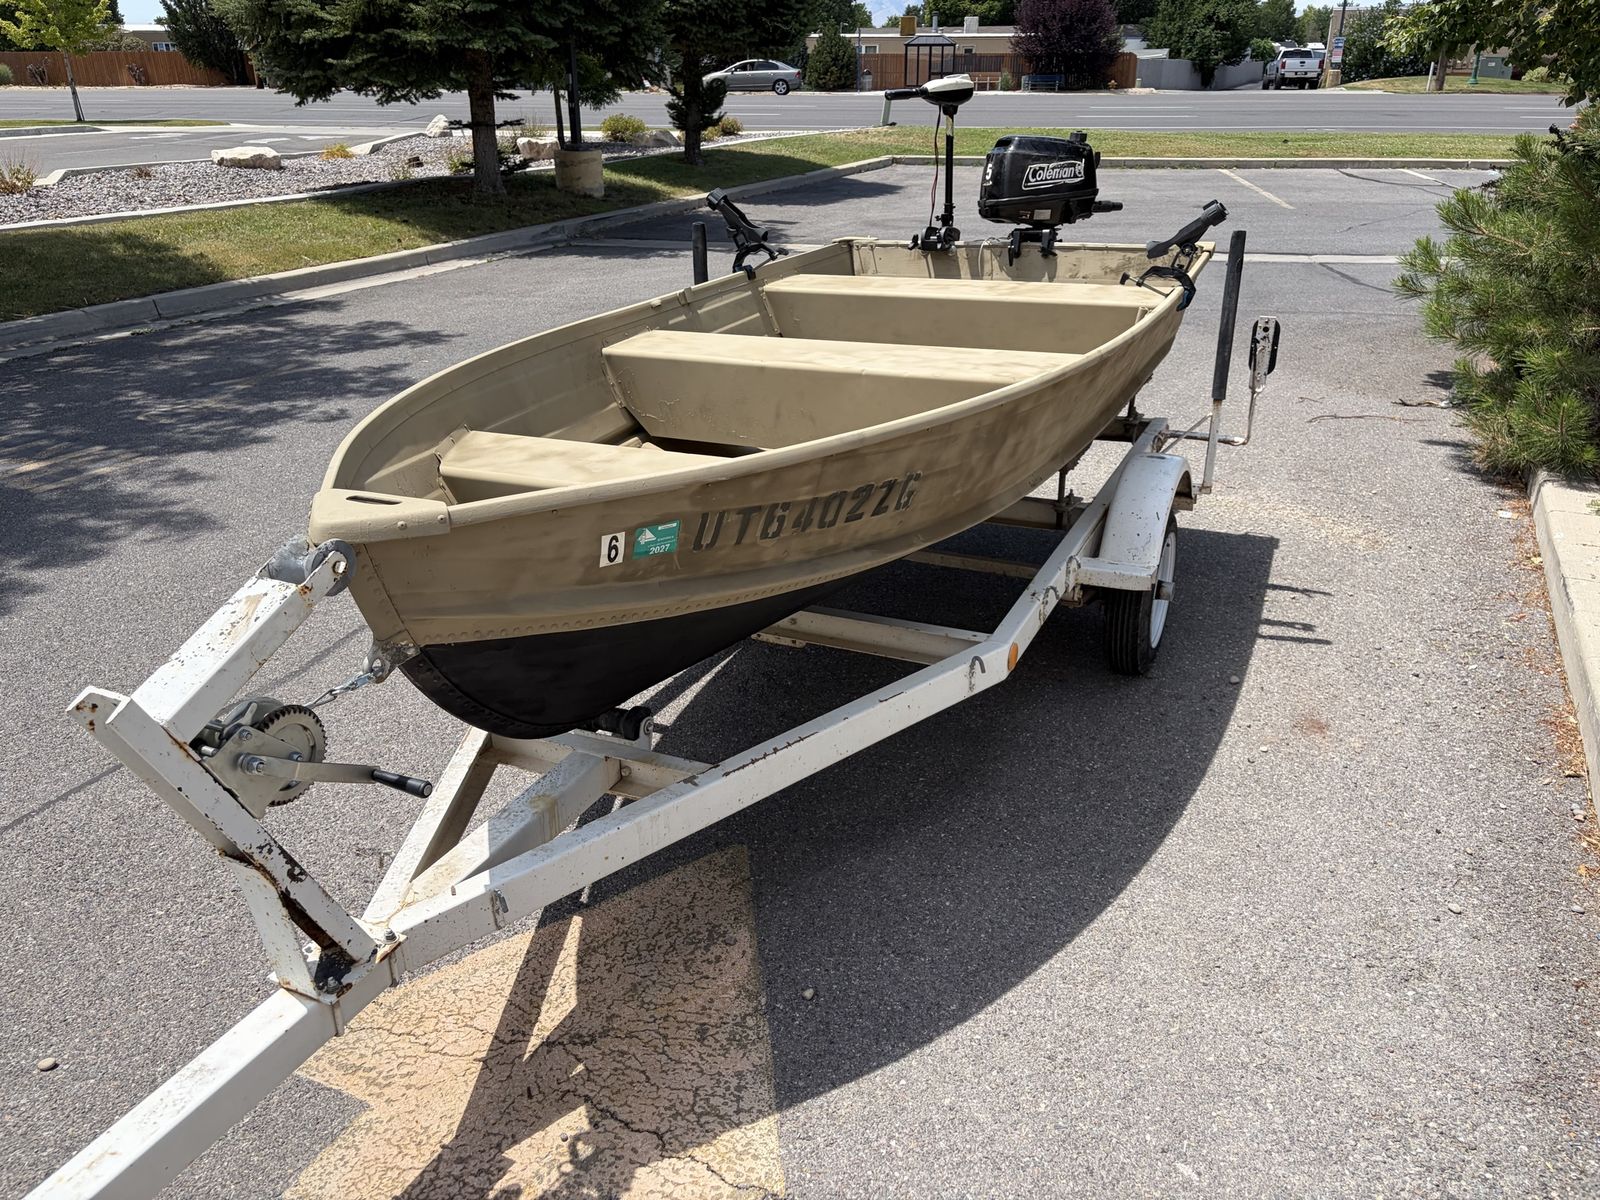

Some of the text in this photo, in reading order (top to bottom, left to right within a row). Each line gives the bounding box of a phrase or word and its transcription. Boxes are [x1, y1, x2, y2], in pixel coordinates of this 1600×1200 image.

[985, 163, 993, 181] 5
[1027, 165, 1075, 183] Coleman
[607, 535, 619, 563] 6
[649, 543, 671, 555] 2027
